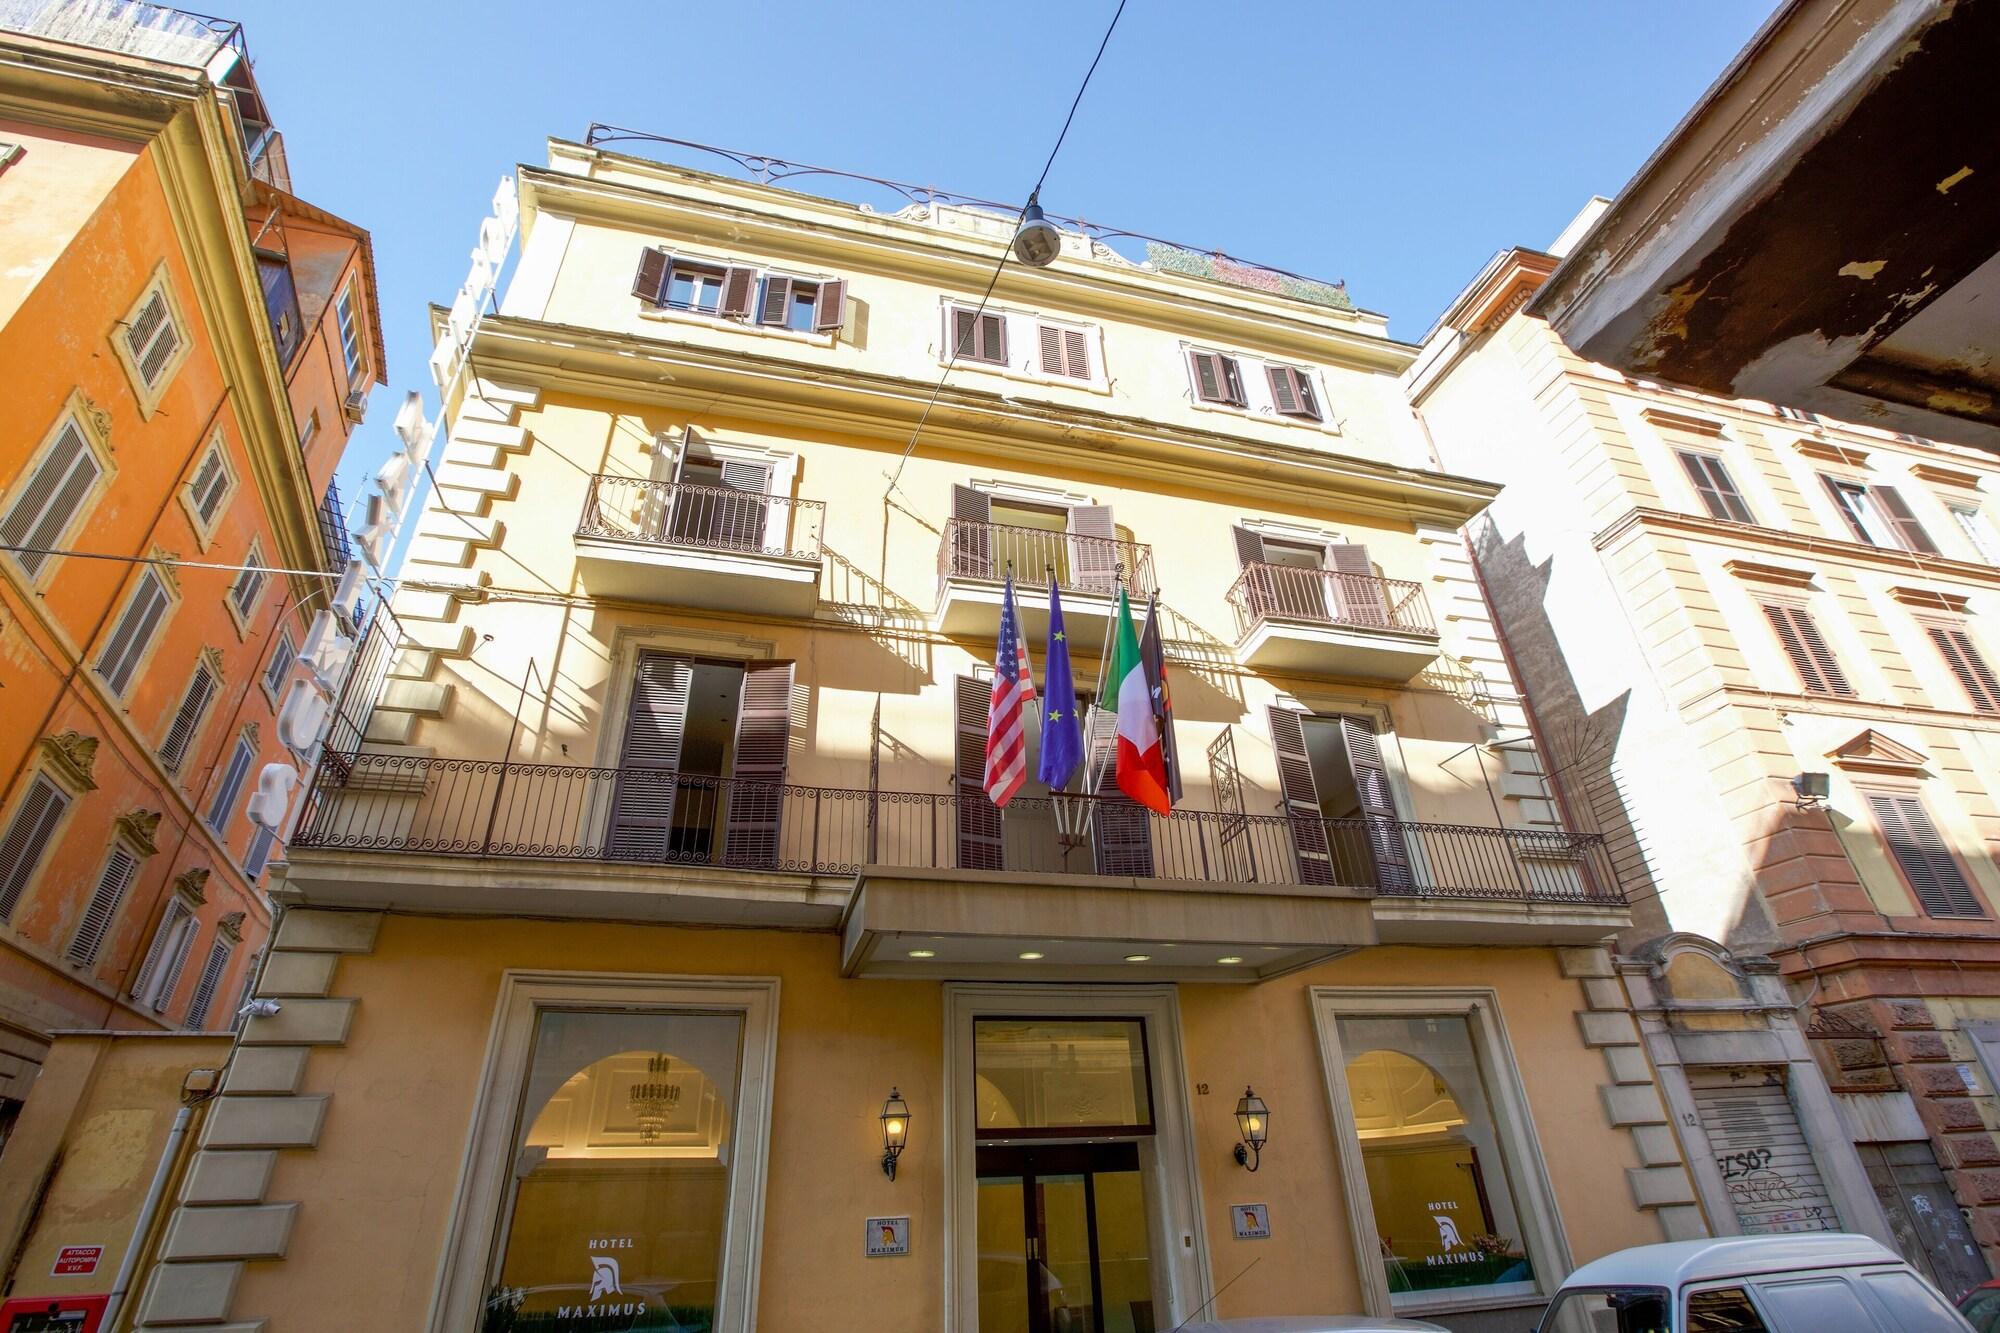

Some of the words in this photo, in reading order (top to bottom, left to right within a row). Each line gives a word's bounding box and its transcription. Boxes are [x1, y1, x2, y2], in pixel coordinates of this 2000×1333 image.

[1196, 1083, 1210, 1095] 12
[1682, 1113, 1696, 1127] 12
[1428, 1201, 1459, 1211] HOTEL
[589, 1238, 634, 1249] HOTEL
[1426, 1251, 1485, 1267] MAXIMUS
[557, 1303, 647, 1319] MAXIMUS
